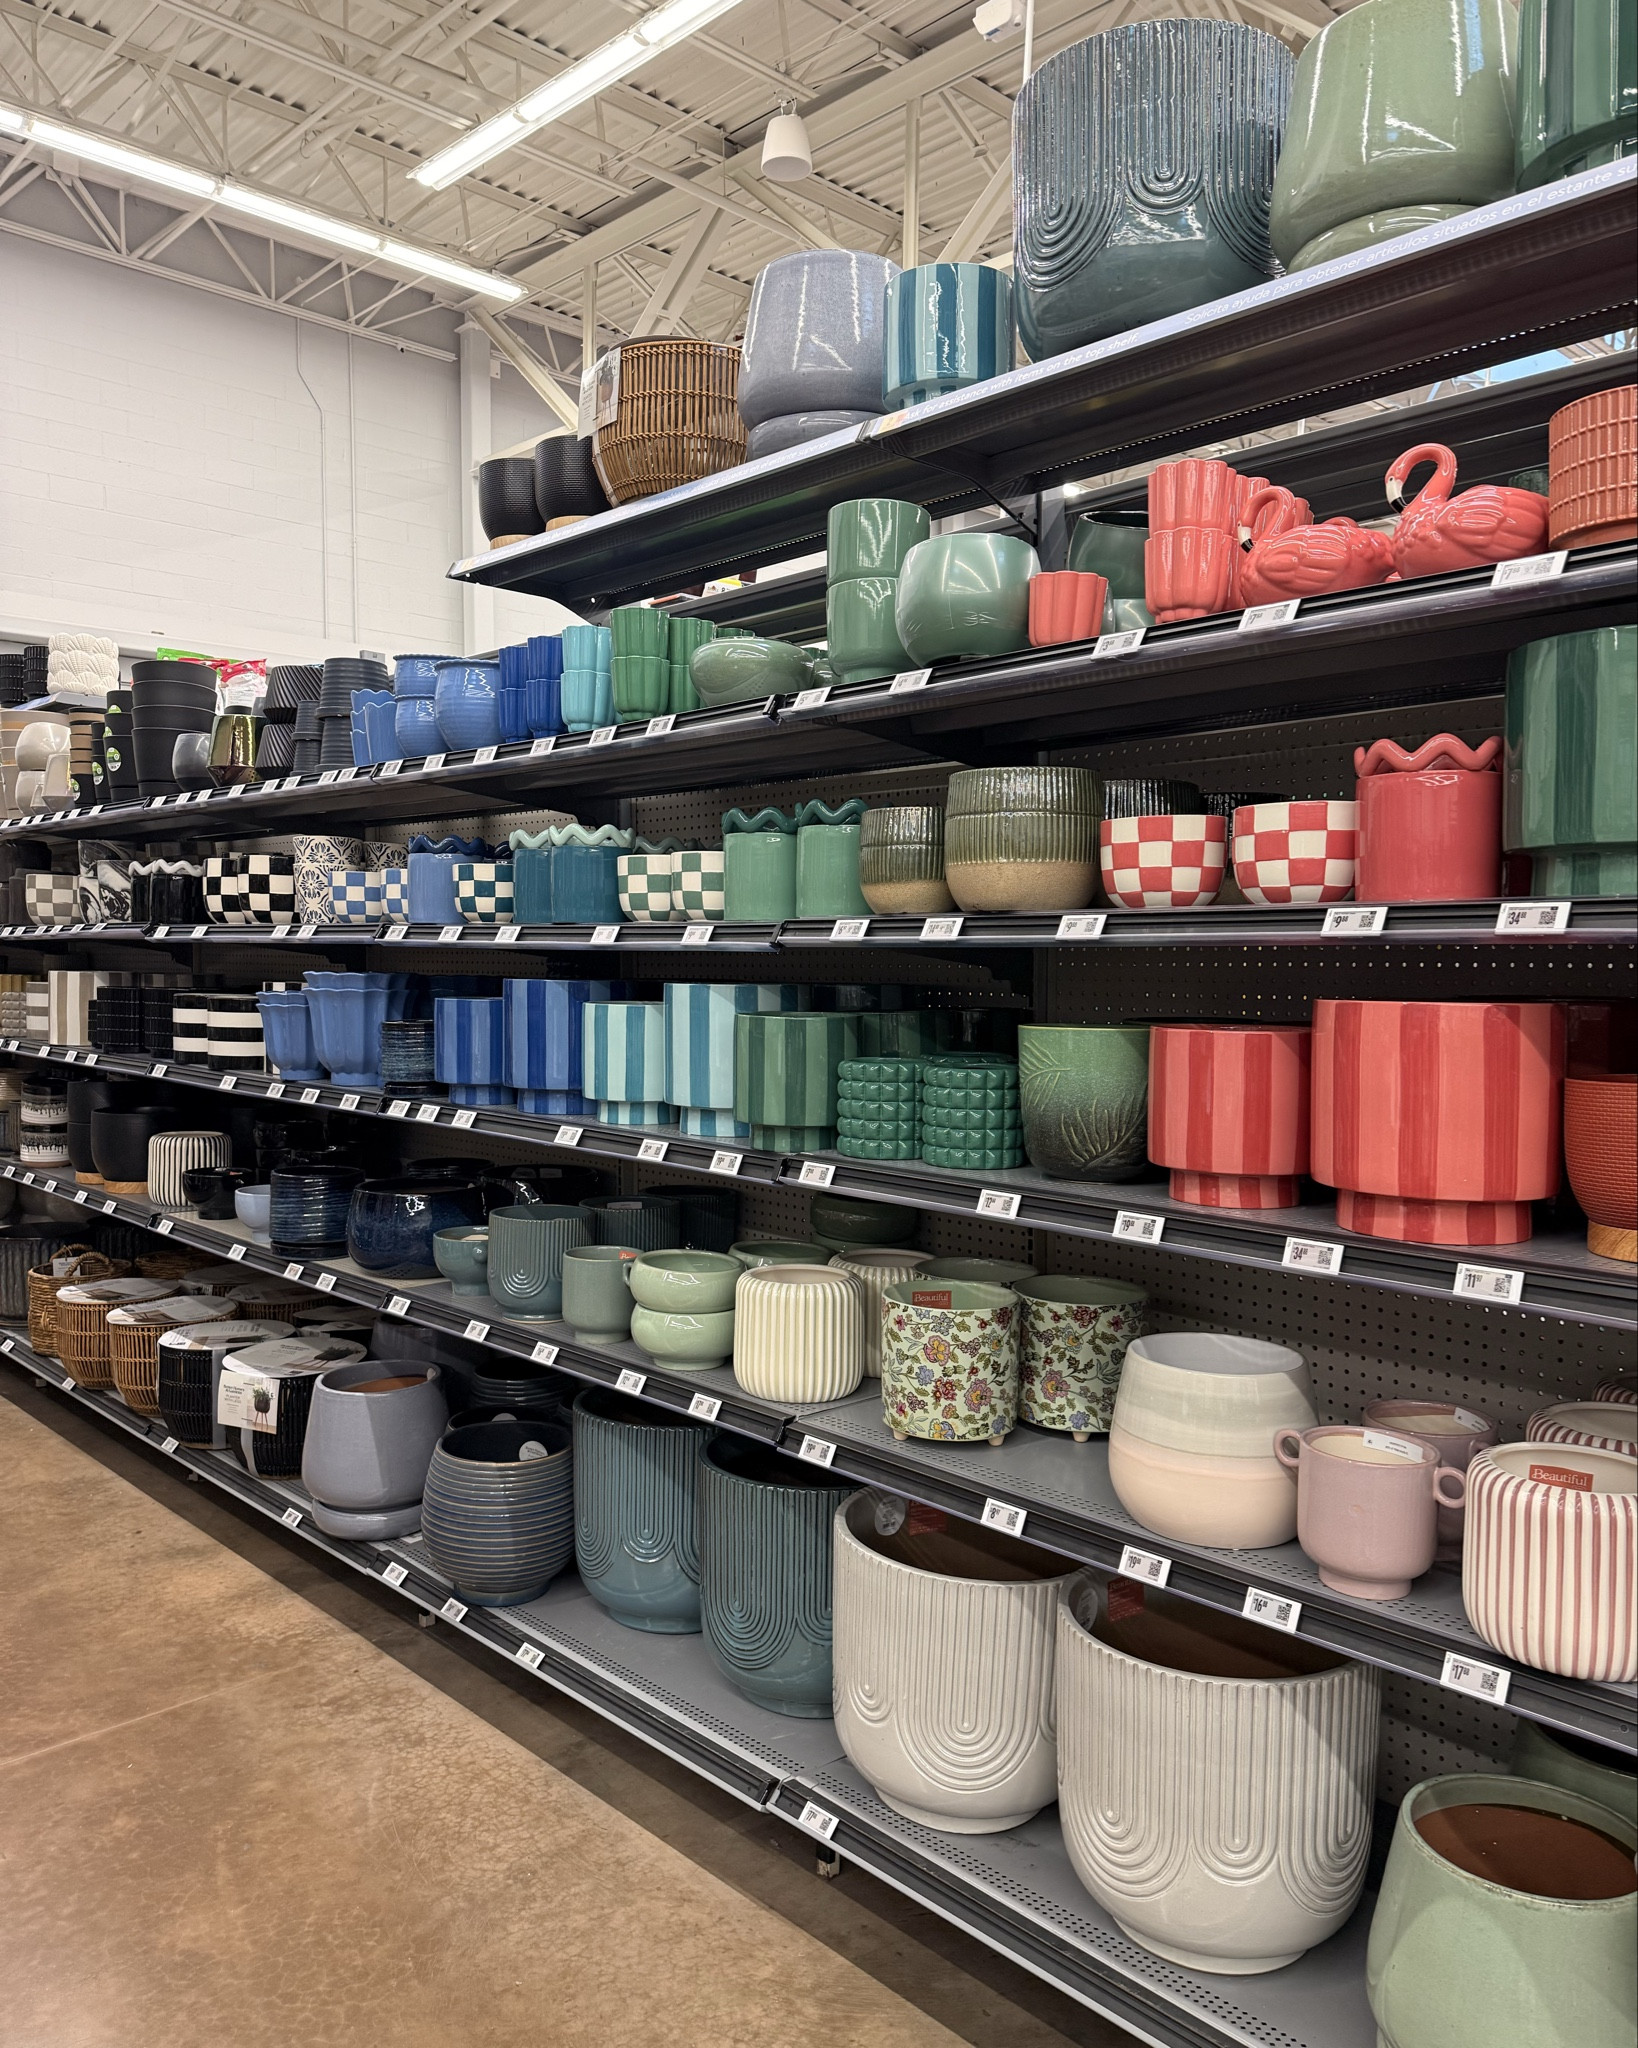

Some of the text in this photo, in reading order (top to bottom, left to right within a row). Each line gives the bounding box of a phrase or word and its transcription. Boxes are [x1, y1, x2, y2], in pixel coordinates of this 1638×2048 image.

[1184, 302, 1229, 325] Solicita
[1232, 288, 1270, 309] ayuda
[1272, 278, 1304, 299] para
[1306, 257, 1364, 283] obtener
[1366, 234, 1430, 262] artículos
[1432, 211, 1498, 240] situados
[1501, 202, 1523, 216] en
[1527, 192, 1544, 208] el
[1549, 172, 1613, 201] estante
[904, 332, 1139, 424] Ask for assistance with items on the top shelf.
[914, 1292, 949, 1302] Beautiful
[1531, 1468, 1588, 1486] Beautiful
